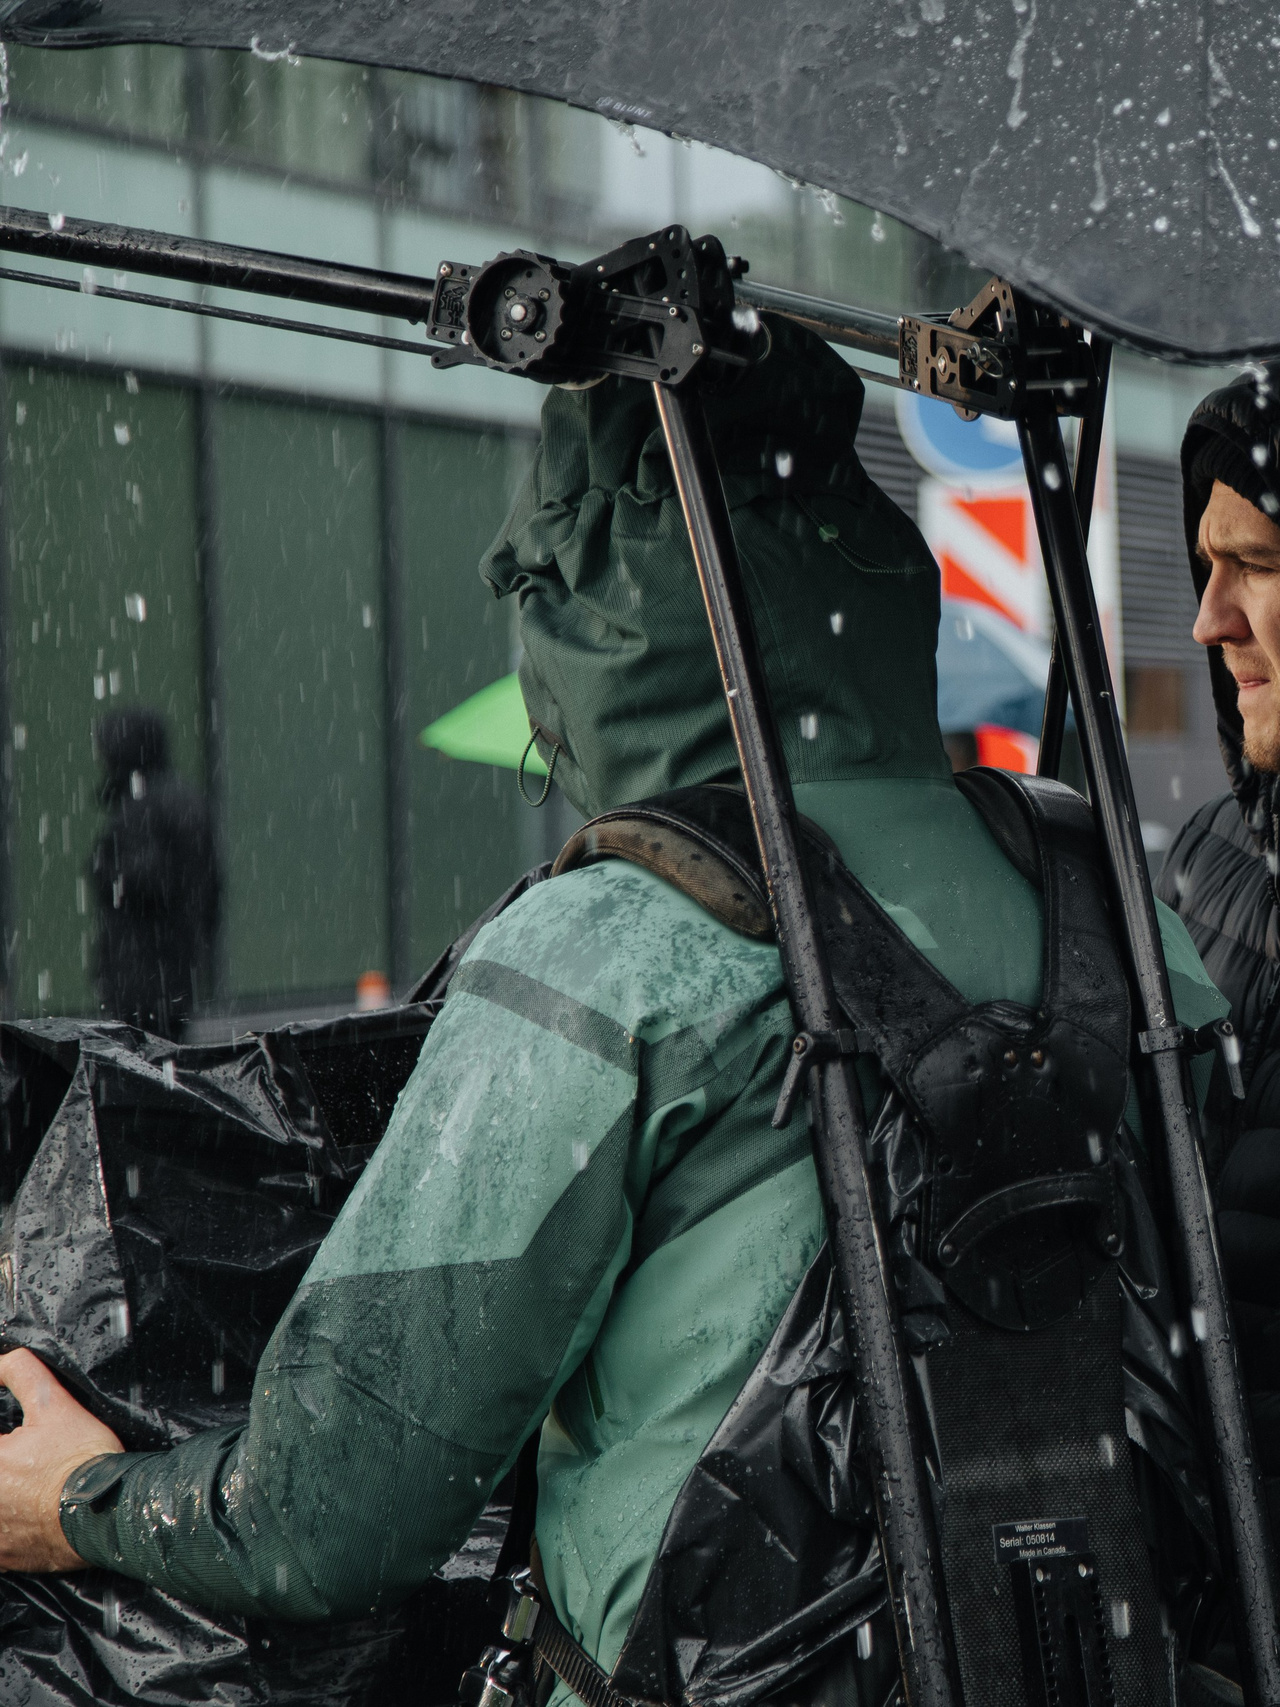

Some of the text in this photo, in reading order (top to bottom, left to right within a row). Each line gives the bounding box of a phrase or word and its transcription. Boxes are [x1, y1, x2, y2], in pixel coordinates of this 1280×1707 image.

[613, 102, 651, 117] BLUNT
[1014, 1522, 1056, 1533] Walter Klassen
[999, 1532, 1056, 1548] Serial: 050814
[1019, 1545, 1067, 1558] Made in Canada
